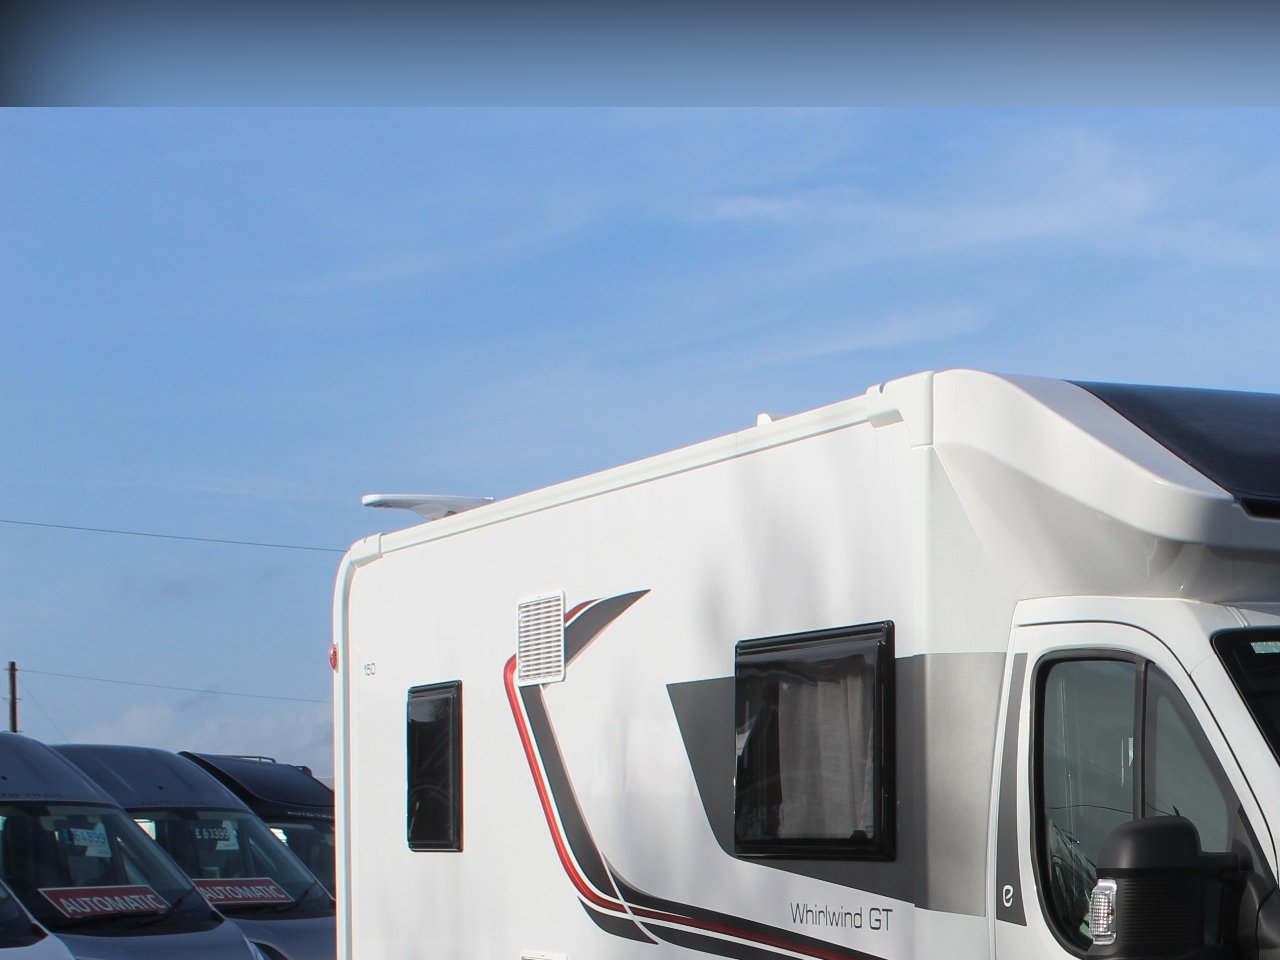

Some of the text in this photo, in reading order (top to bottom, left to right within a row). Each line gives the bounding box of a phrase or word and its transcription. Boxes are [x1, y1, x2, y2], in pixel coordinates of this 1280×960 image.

[363, 662, 376, 677] 150
[201, 885, 285, 899] AUTOMATIC
[60, 893, 168, 914] AUTOMATIC
[790, 902, 893, 931] Whirlwind GT
